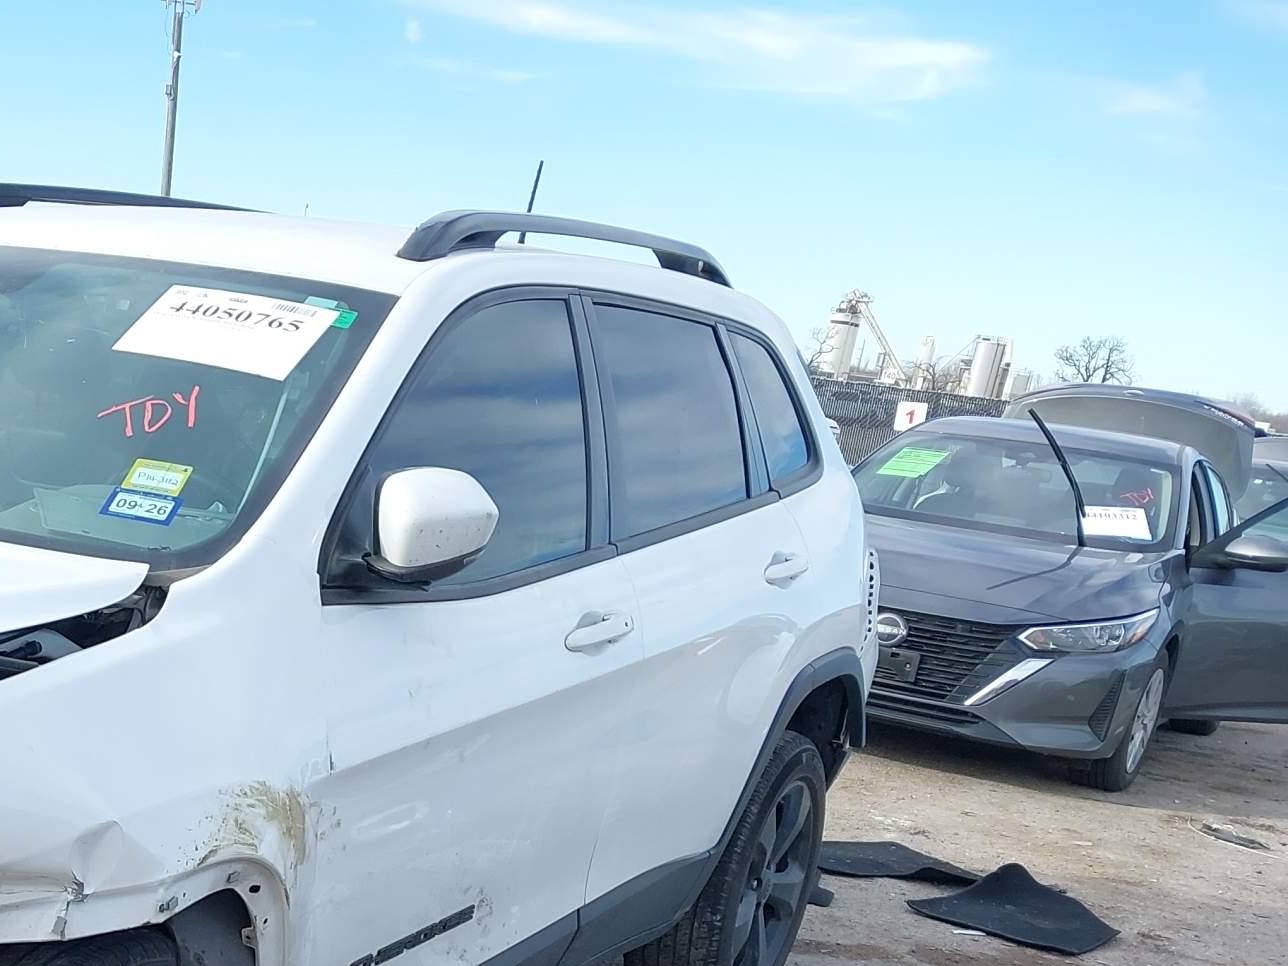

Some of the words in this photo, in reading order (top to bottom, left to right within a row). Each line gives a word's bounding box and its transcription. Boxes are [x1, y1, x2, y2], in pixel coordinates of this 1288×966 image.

[168, 301, 304, 333] 44050765
[96, 384, 200, 438] TDY
[905, 409, 916, 425] 1
[115, 498, 138, 511] 09
[144, 502, 168, 516] 26
